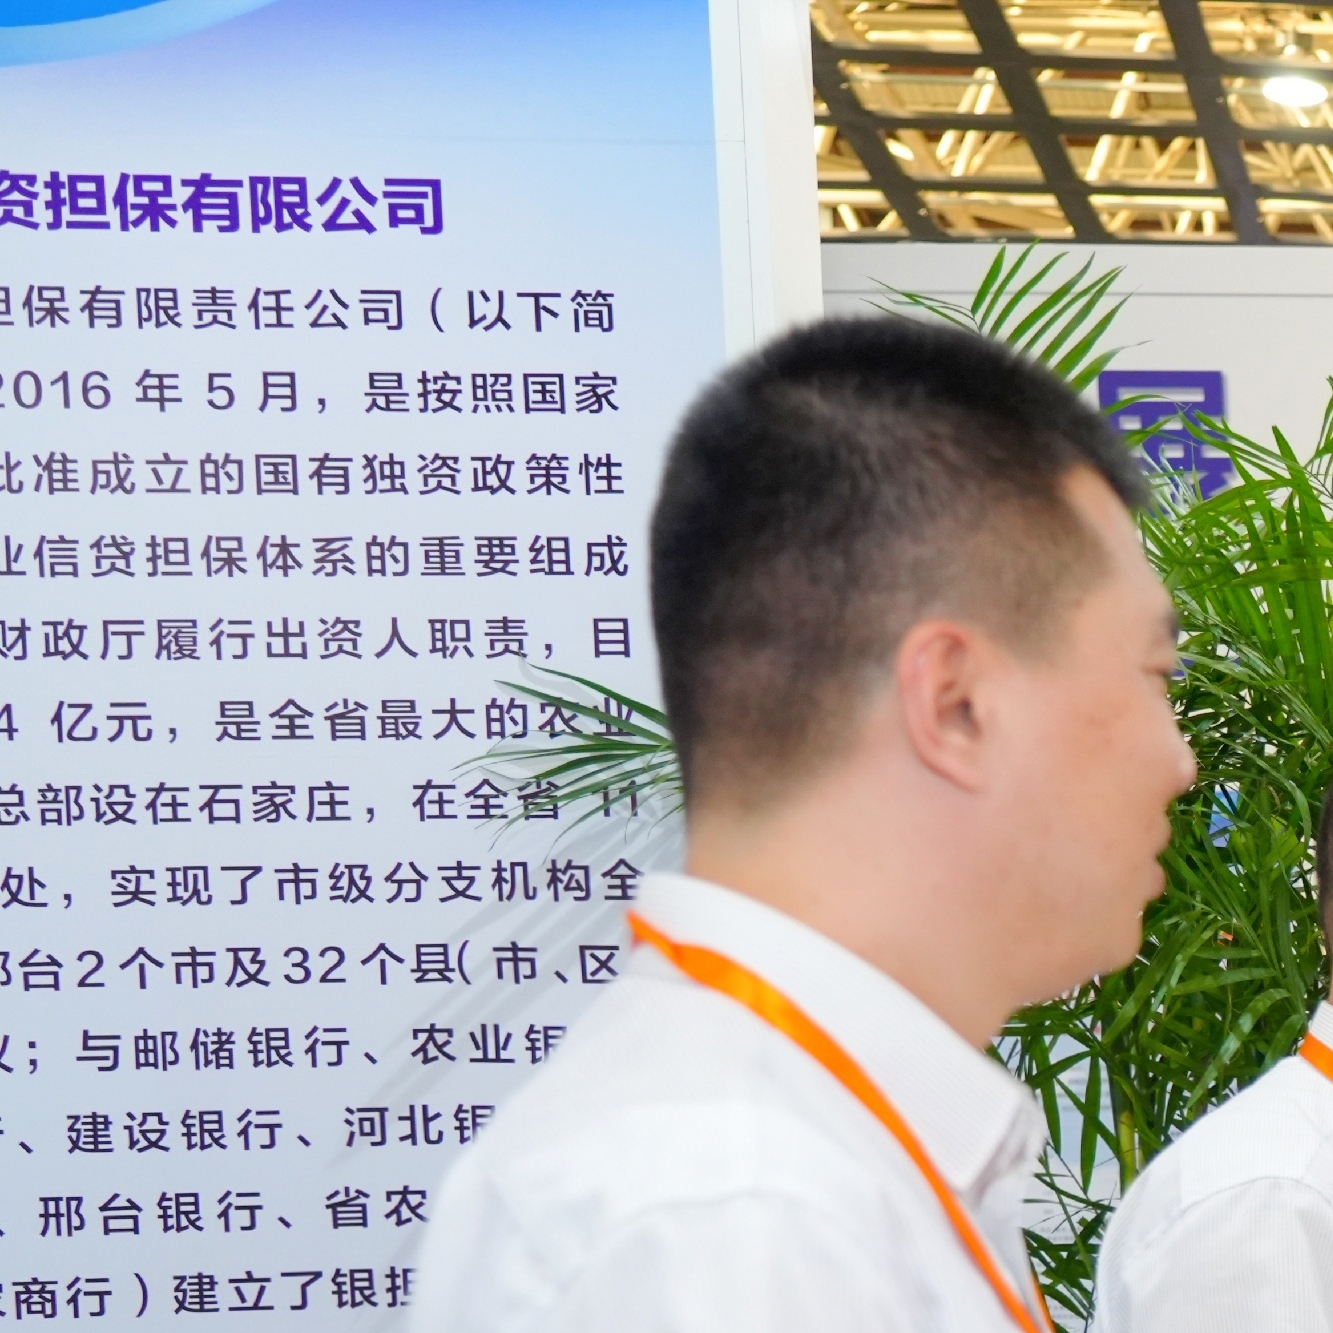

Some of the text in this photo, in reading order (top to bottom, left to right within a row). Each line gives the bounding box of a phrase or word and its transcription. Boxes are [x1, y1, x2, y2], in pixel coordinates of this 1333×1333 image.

[0, 169, 446, 236] 资担保有限公司
[0, 368, 620, 417] 016年5月，是按照国家
[0, 940, 620, 992] 台2个市及32个县（市、区
[0, 1023, 567, 1075] ；与邮储银行、农业银
[0, 1103, 496, 1156] 、建设银行、河北银
[0, 1266, 417, 1320] 商行）建立了银担
